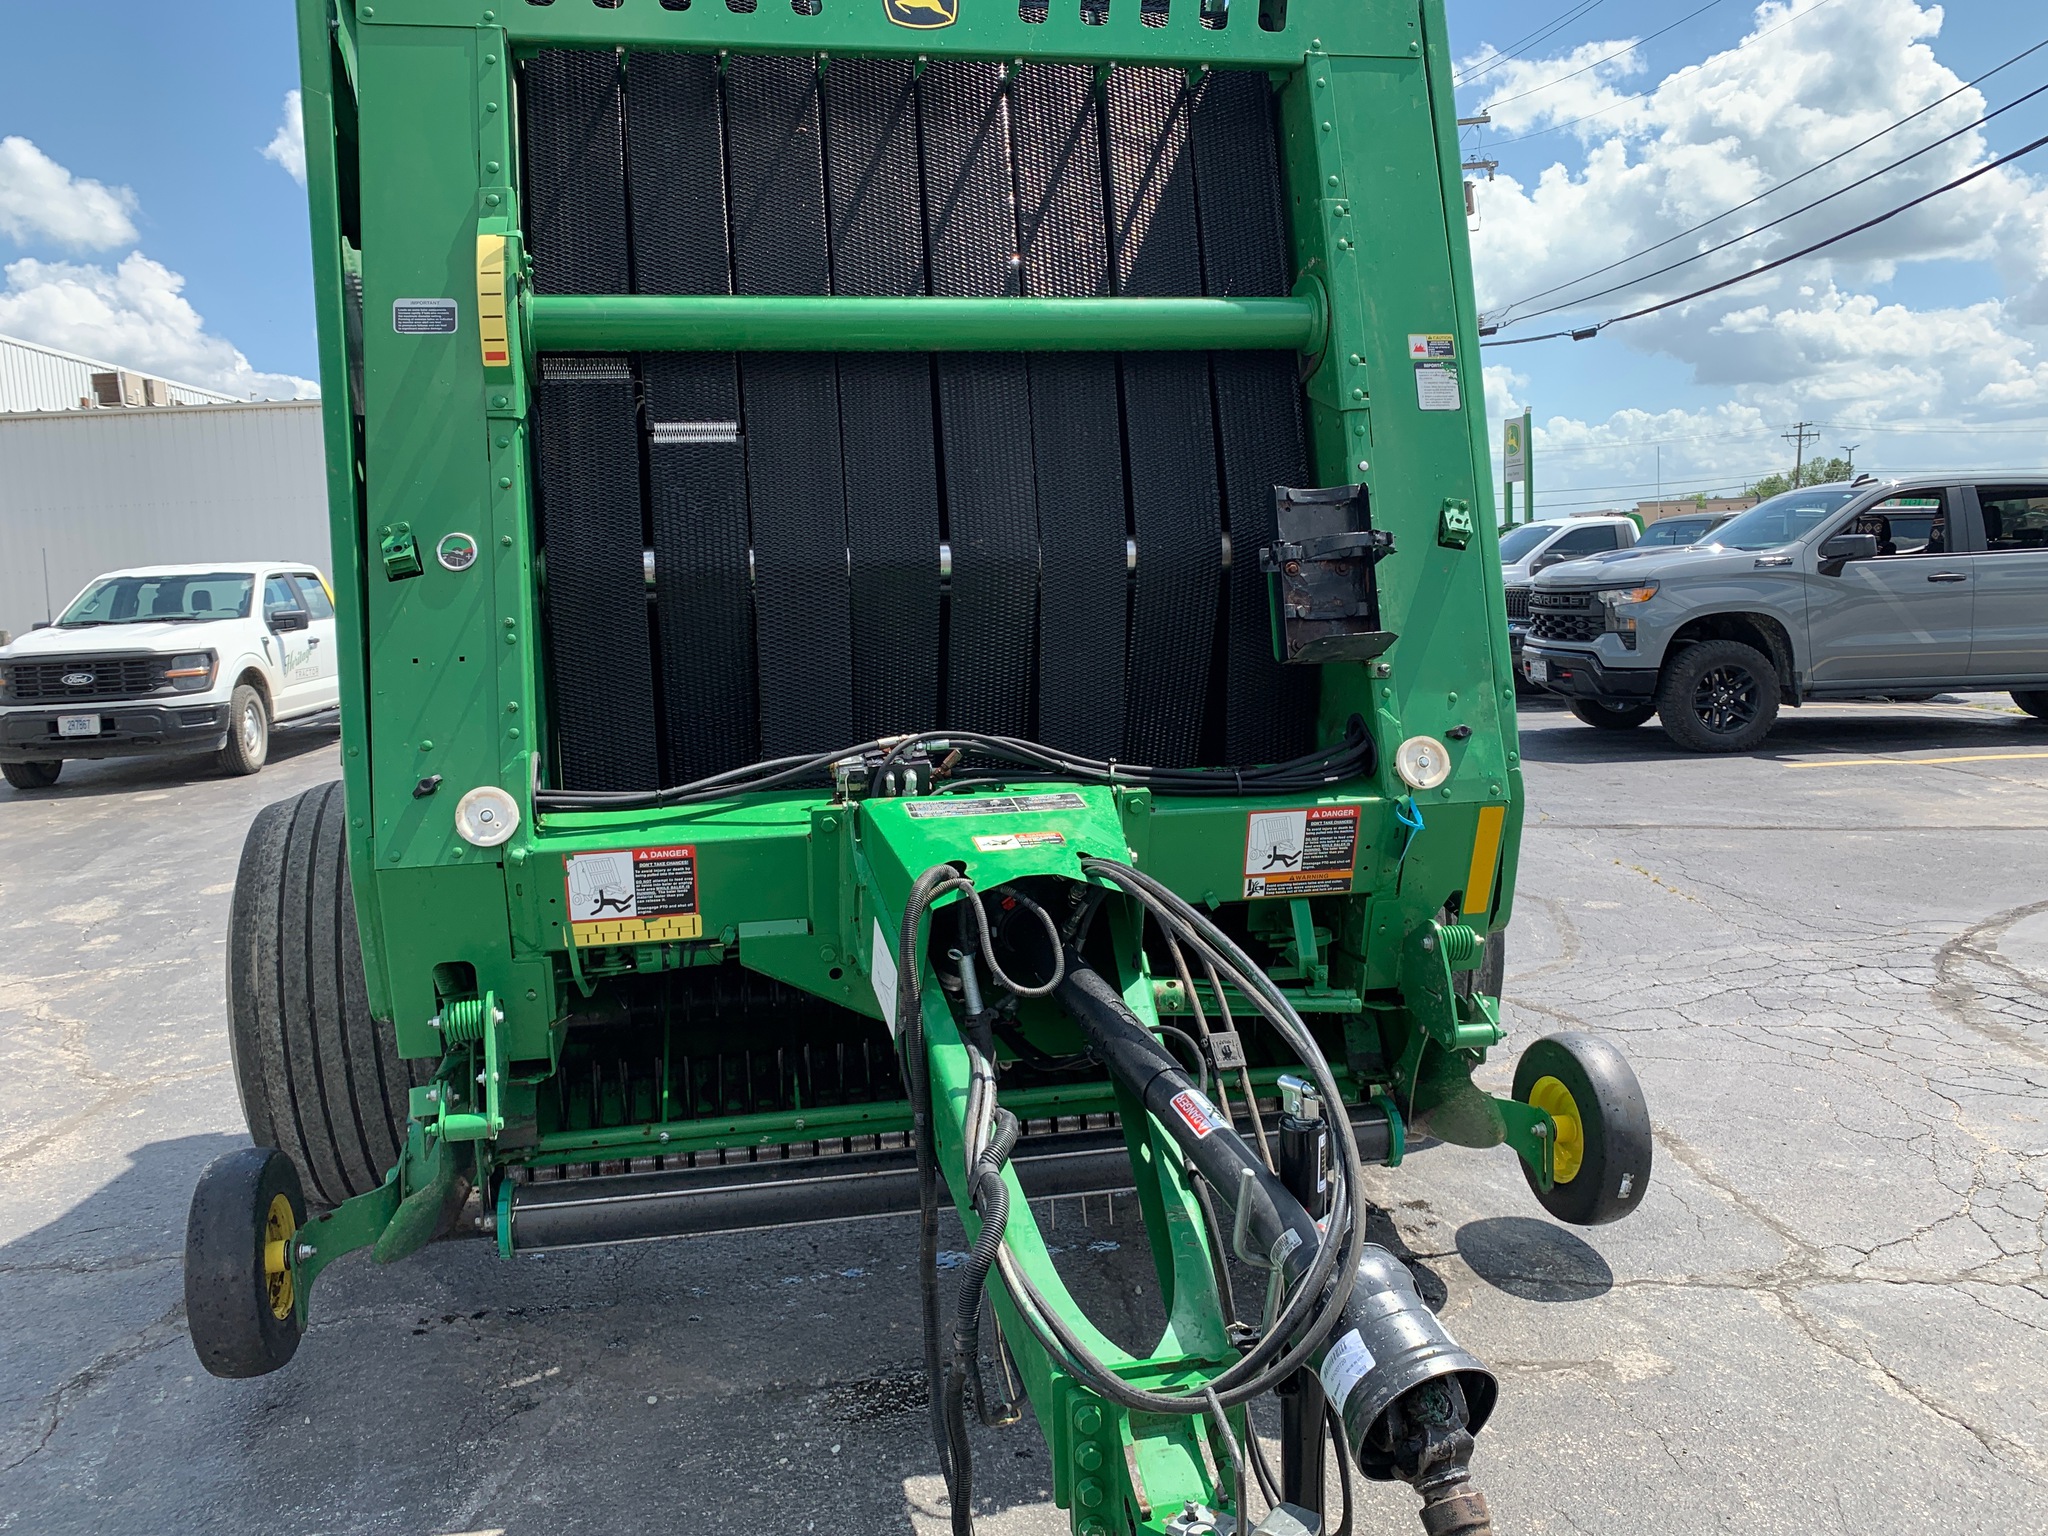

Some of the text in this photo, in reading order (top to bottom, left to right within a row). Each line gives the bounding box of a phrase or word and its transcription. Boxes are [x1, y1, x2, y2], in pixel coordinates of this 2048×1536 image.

[295, 667, 319, 679] TRACTOR
[1321, 809, 1354, 817] DANGER
[650, 849, 688, 858] DANGER
[1176, 1094, 1205, 1125] DANGER
